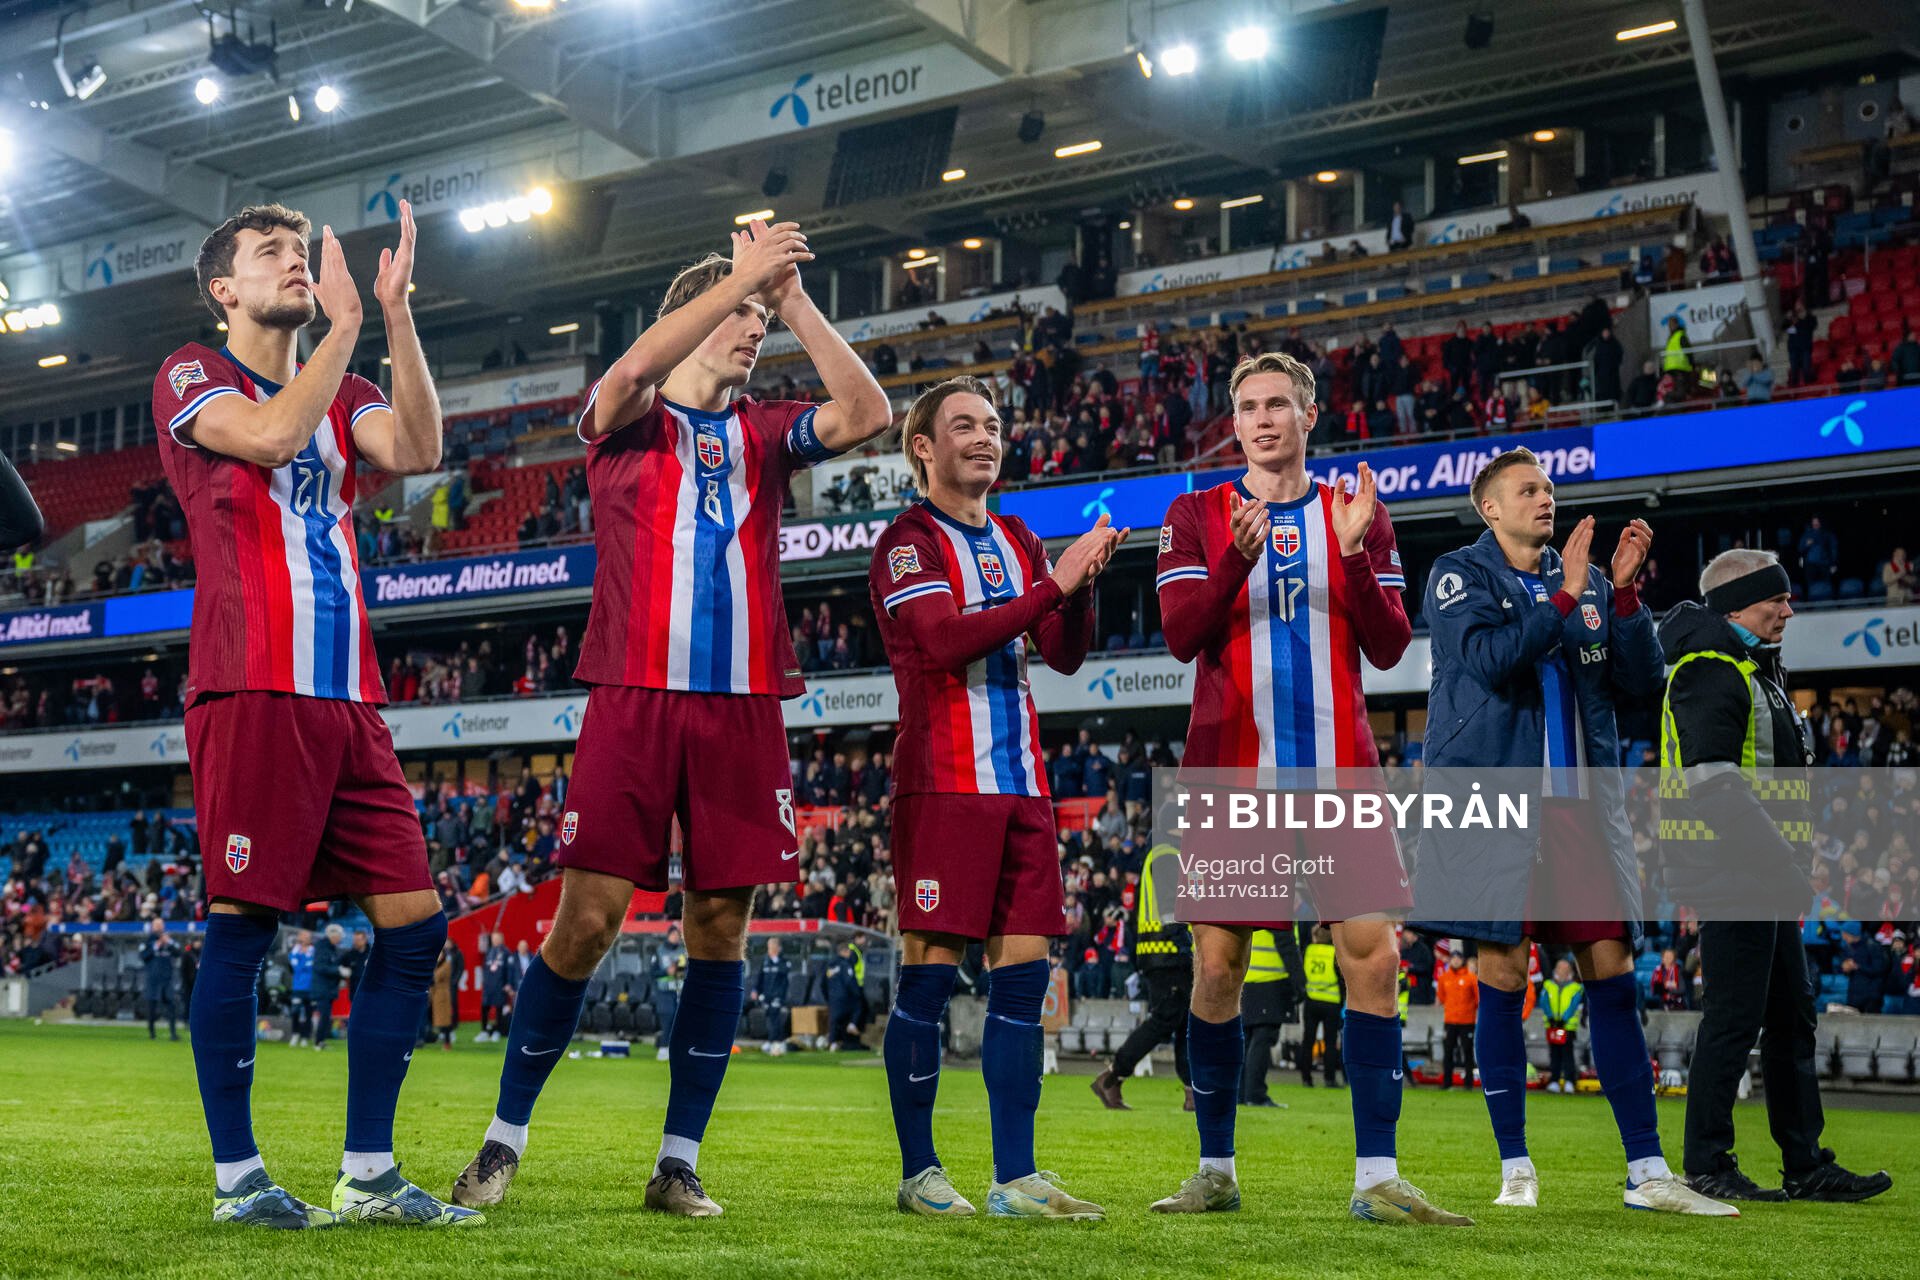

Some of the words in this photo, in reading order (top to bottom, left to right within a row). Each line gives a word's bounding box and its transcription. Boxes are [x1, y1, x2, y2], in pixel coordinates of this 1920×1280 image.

[815, 65, 923, 111] telenor
[402, 167, 486, 204] telenor
[117, 239, 186, 272] telenor
[295, 467, 329, 517] 21
[704, 480, 725, 527] 8
[375, 574, 454, 601] Telenor.
[455, 561, 514, 593] Alltid
[514, 555, 570, 587] med.
[1275, 578, 1306, 622] 17
[824, 690, 883, 711] telenor
[1116, 671, 1185, 693] telenor
[462, 715, 510, 733] telenor
[776, 789, 796, 838] 8
